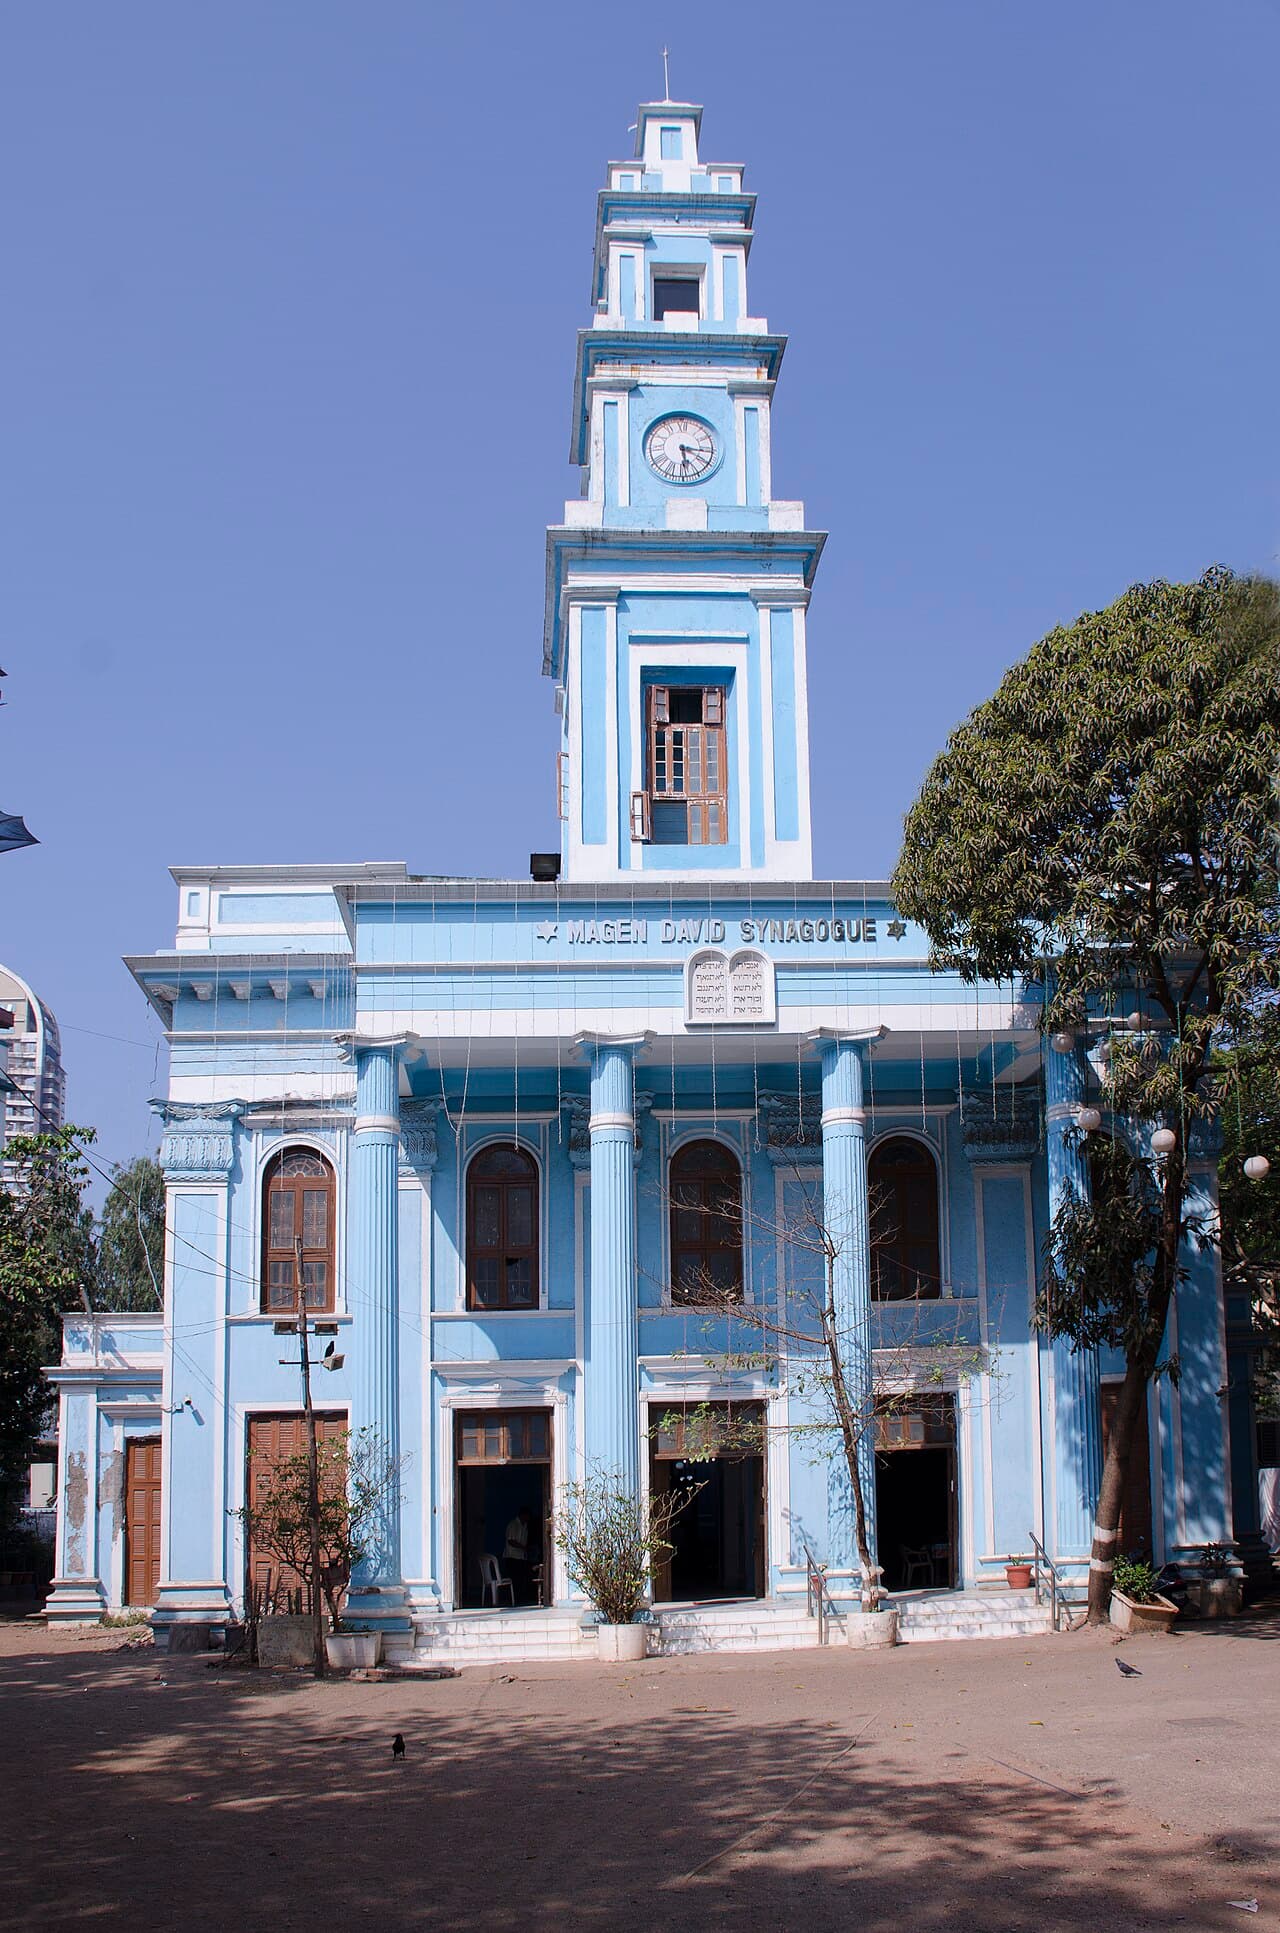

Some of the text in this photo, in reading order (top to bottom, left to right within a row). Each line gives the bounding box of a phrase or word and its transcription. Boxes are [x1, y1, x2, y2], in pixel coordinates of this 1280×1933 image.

[568, 918, 877, 944] MAGEN DAVID SYNAGOGUE
